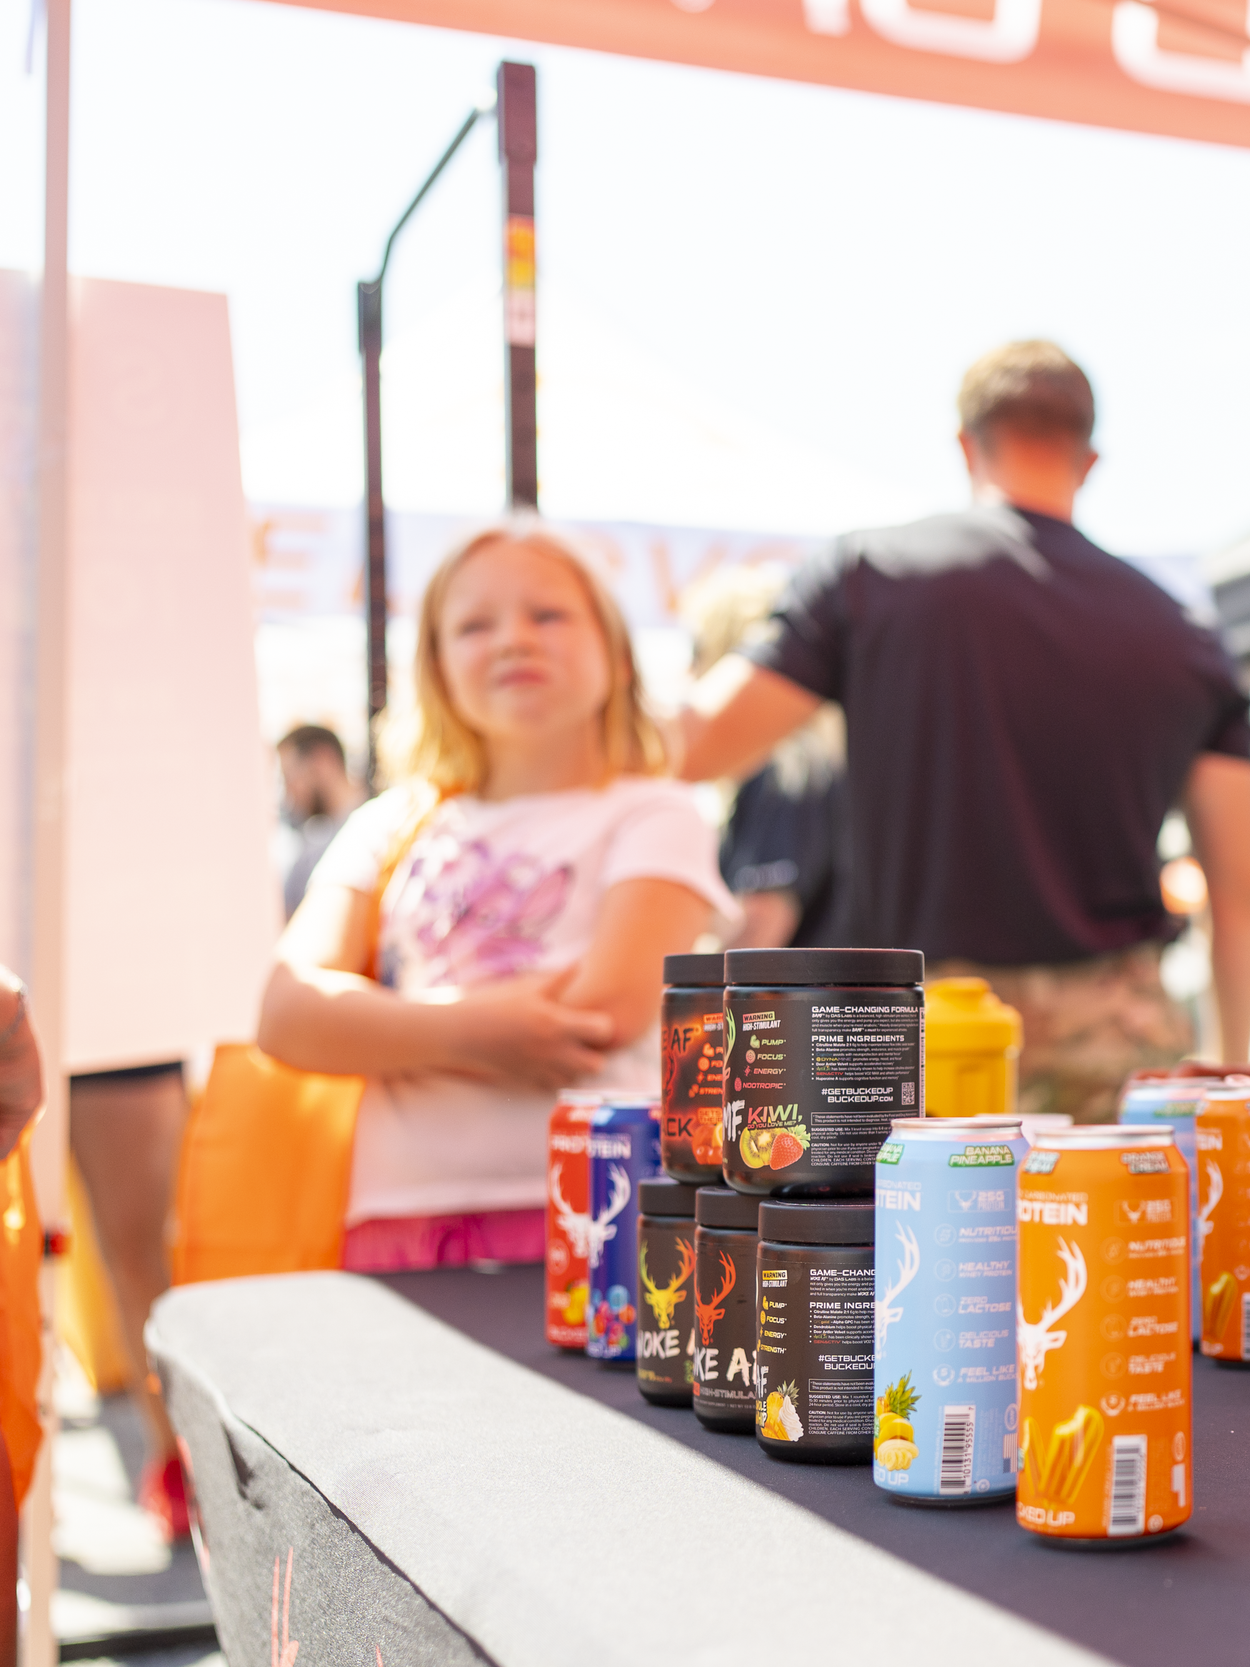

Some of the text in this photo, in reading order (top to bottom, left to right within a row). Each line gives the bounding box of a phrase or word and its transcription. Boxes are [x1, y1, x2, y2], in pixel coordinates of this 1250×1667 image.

[743, 1013, 774, 1021] WARNING
[742, 1020, 781, 1031] HIGH-STIMULANT
[821, 1087, 893, 1095] #GETBUCKEDUP
[747, 1104, 803, 1124] KIWI,
[965, 1146, 1011, 1156] BANANA
[950, 1155, 1013, 1164] PINEAPPLE
[958, 1261, 1010, 1271] HEALTHY
[960, 1296, 988, 1304] ZERO
[958, 1302, 1012, 1314] LACTOSE
[959, 1329, 1009, 1339] DELICIOUS
[959, 1339, 995, 1349] TASTE
[693, 1347, 719, 1382] KE
[960, 1364, 1015, 1376] FEEL LIKE
[963, 1421, 974, 1479] 10131 95555
[887, 1472, 909, 1485] UP
[1046, 1510, 1075, 1527] UP
